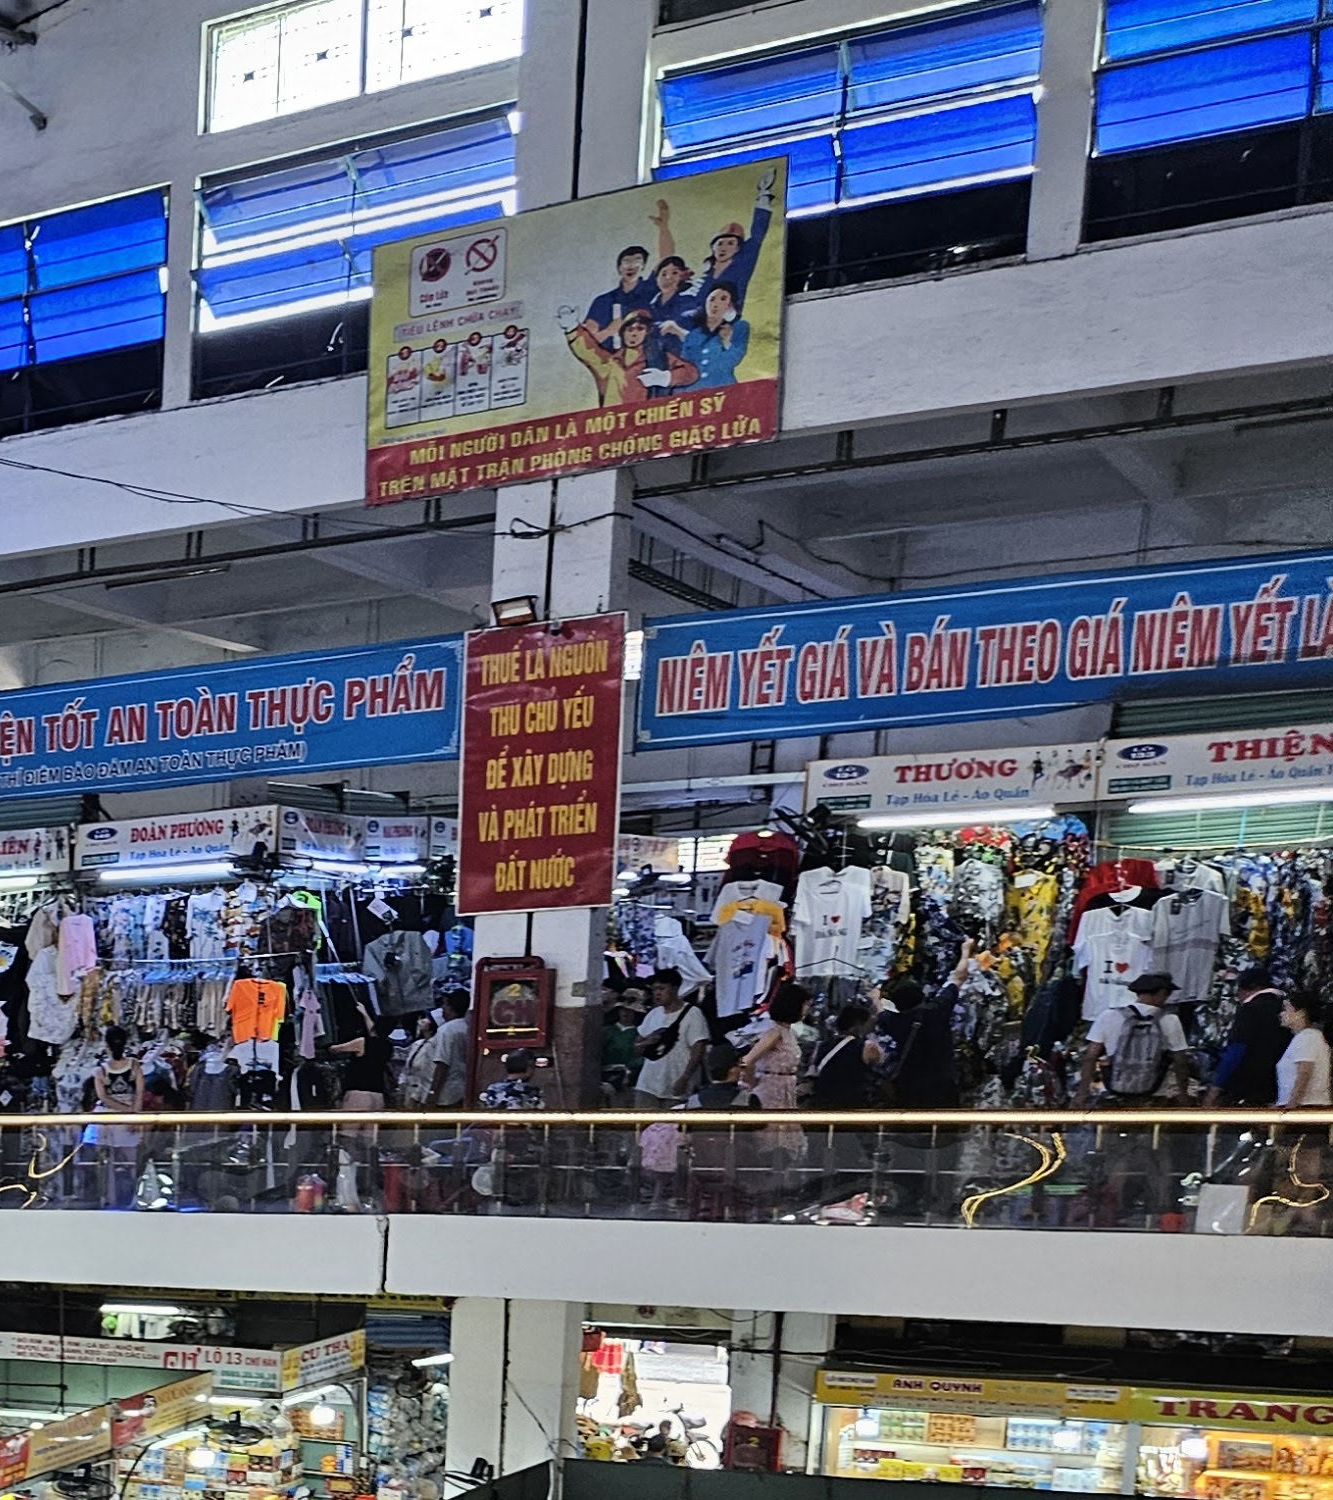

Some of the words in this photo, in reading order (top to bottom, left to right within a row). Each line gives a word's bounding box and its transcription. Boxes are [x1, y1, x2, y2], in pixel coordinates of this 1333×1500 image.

[511, 425, 548, 450] DÂN
[555, 417, 578, 440] LÀ
[586, 410, 628, 435] MỘT
[635, 396, 693, 427] CHIẾN
[481, 639, 521, 686] THUẾ
[525, 644, 544, 681] LÀ
[549, 631, 609, 678] NGUỒN
[654, 641, 731, 717] NIÊM
[738, 625, 794, 709] YẾT
[797, 624, 852, 703] GIÁ
[856, 621, 899, 699] VÀ
[903, 615, 971, 695] BÁN
[977, 618, 1062, 688] THEO
[1067, 597, 1129, 681] GIÁ
[1130, 593, 1223, 675] NIÊM
[1230, 573, 1302, 666] YẾT
[44, 696, 98, 752] TỐT
[105, 703, 147, 745] AN
[155, 687, 235, 740] TOÀN
[246, 677, 334, 734] THỰC
[344, 653, 446, 719] PHẨM
[490, 704, 520, 737] THU
[563, 685, 594, 730] YẾU
[486, 744, 509, 790] ĐỂ
[511, 748, 544, 788] XÂY
[547, 747, 594, 790] DỰNG
[895, 758, 1018, 784] THƯƠNG
[478, 804, 499, 842] VÀ
[502, 800, 545, 841] PHÁT
[549, 789, 598, 836] TRIỂN
[495, 850, 526, 892] ĐẤT
[529, 848, 575, 889] NƯỚC
[227, 1352, 242, 1365] 13
